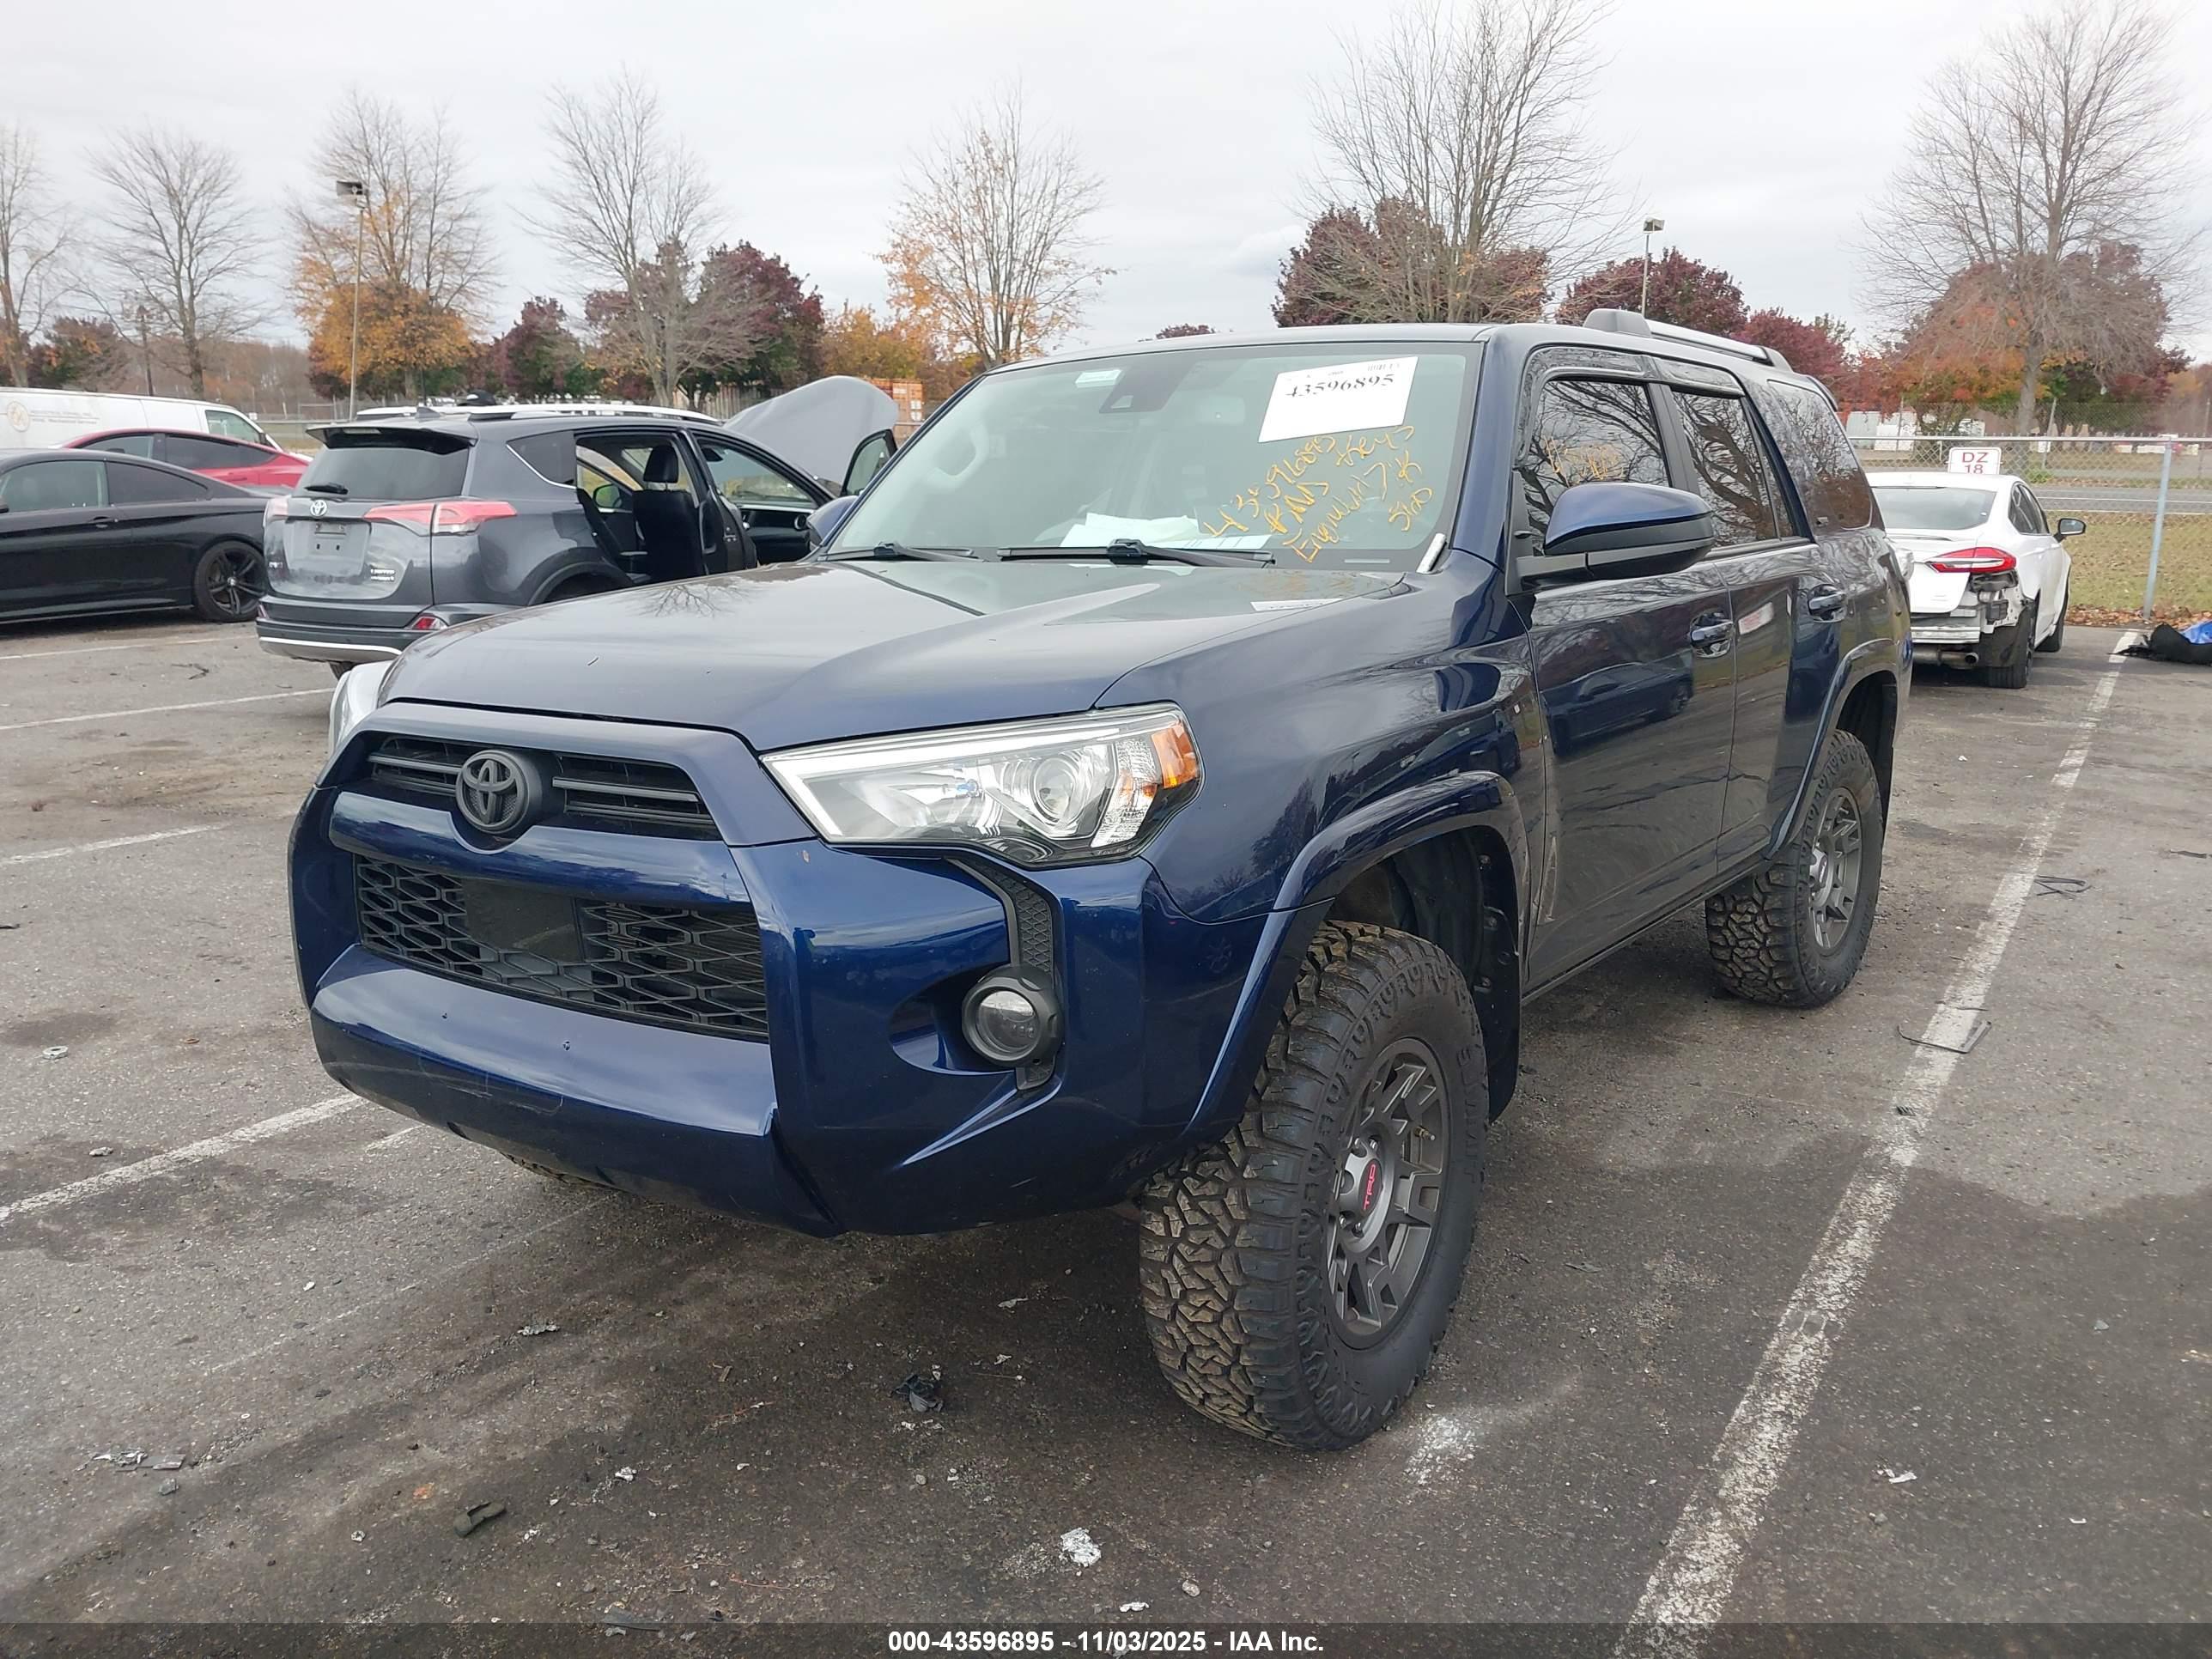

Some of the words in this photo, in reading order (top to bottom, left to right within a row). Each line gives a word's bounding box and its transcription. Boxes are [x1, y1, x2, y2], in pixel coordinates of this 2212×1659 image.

[1285, 374, 1395, 397] 43596895
[1963, 452, 1989, 463] DZ
[1966, 464, 1983, 474] 18
[1364, 1164, 1376, 1210] TRD
